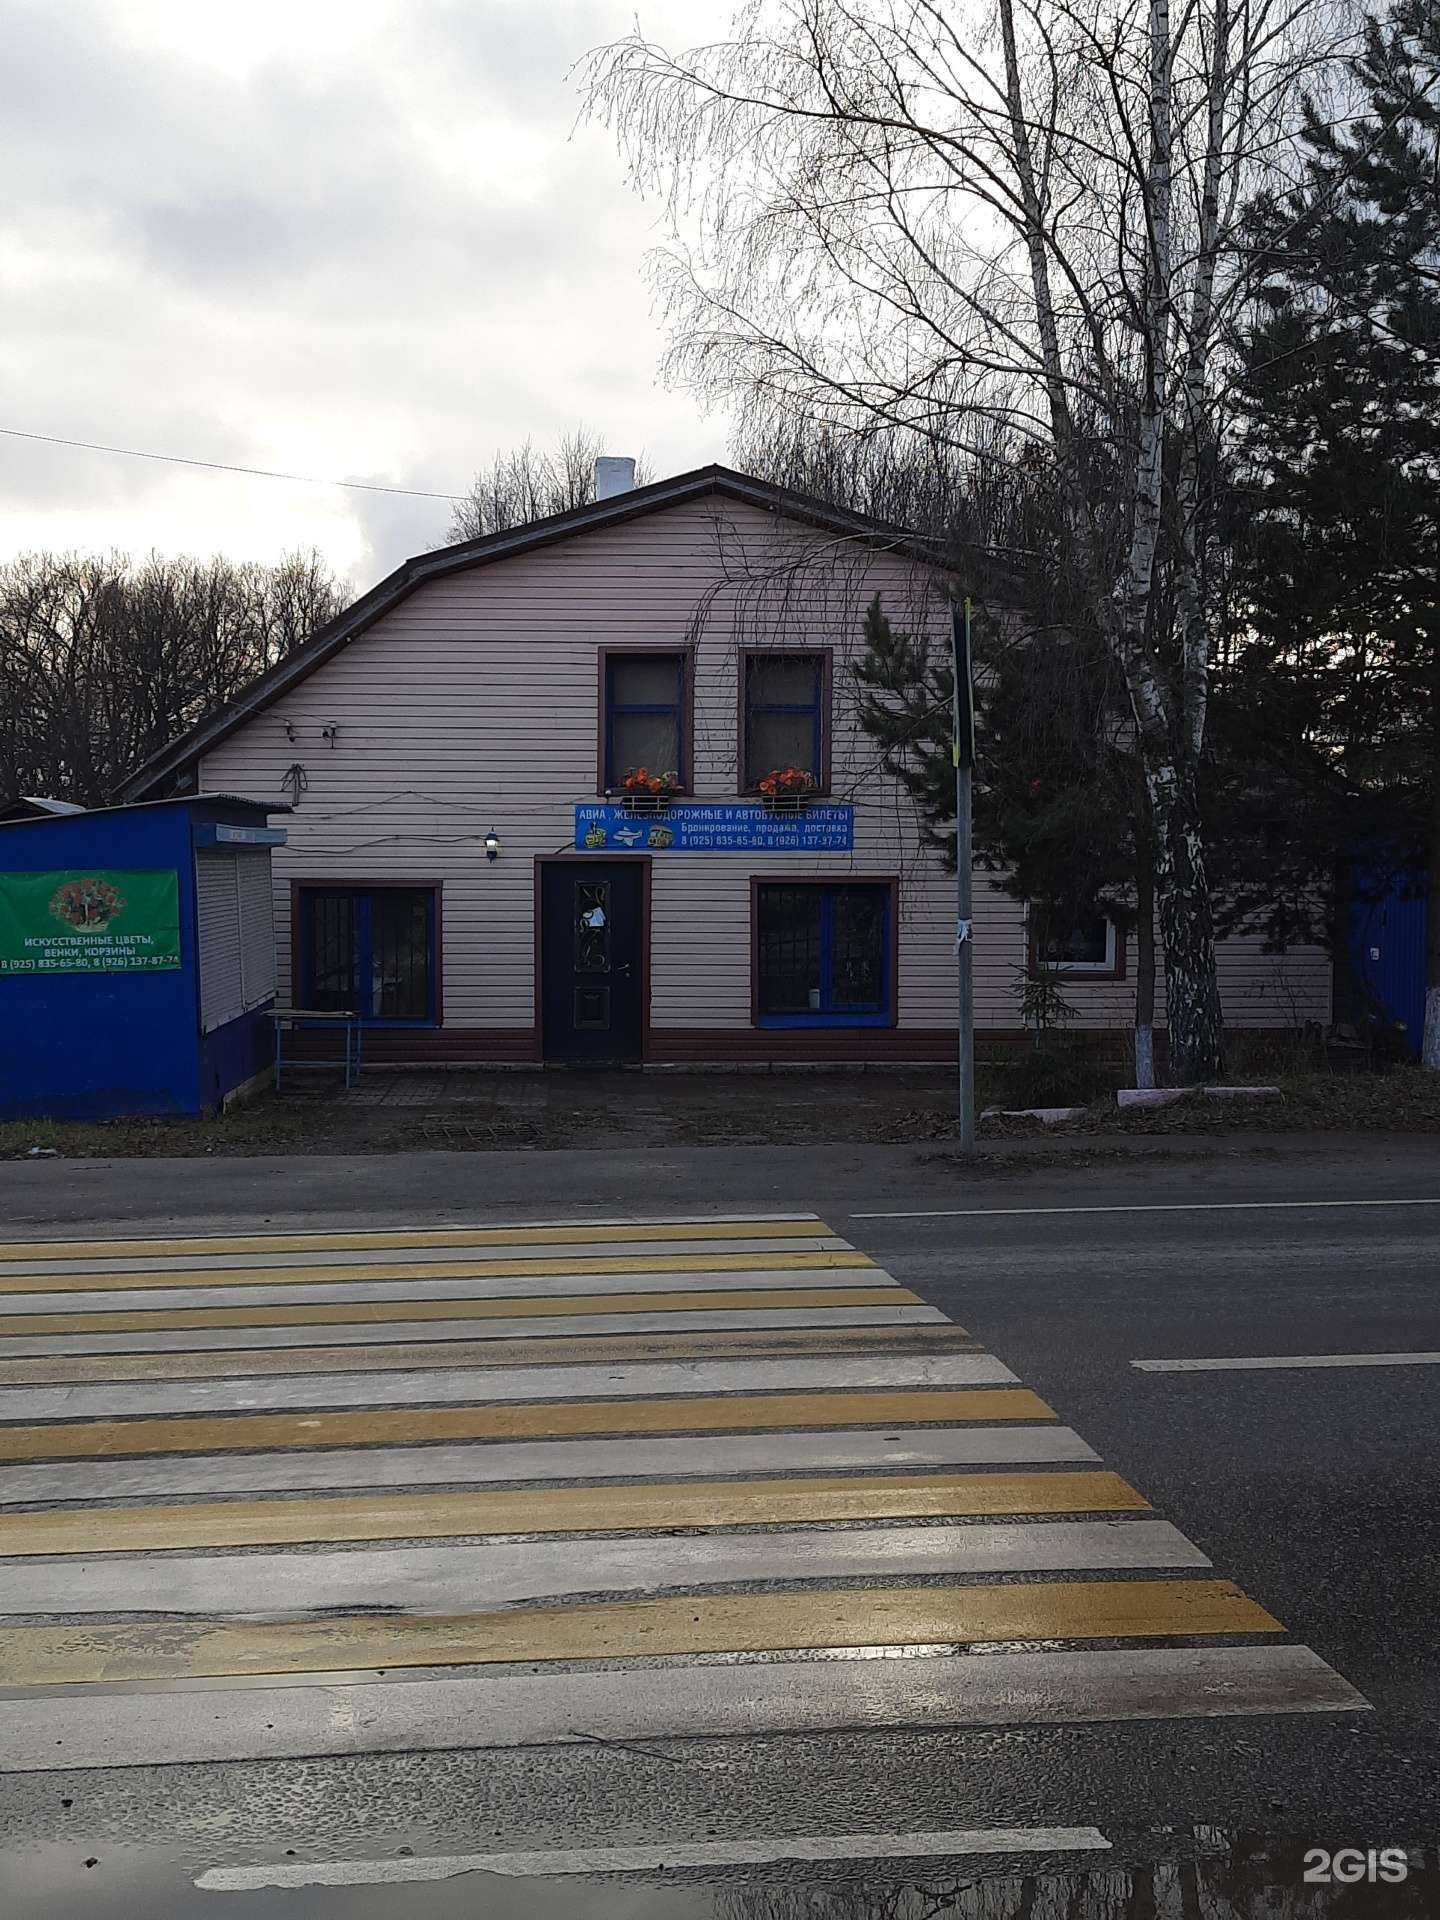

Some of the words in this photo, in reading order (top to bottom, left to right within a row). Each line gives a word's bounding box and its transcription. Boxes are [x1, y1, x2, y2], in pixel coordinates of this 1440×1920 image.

[726, 809, 733, 820] И
[806, 809, 848, 820] БИЛЕТЫ
[804, 824, 848, 833] доставка
[24, 936, 113, 946] ИСКУССТВЕННЫЕ
[115, 935, 154, 945] ЦВЕТЫ,
[44, 948, 82, 958] ВЕНКИ,
[85, 946, 136, 956] КОРЗИНЫ
